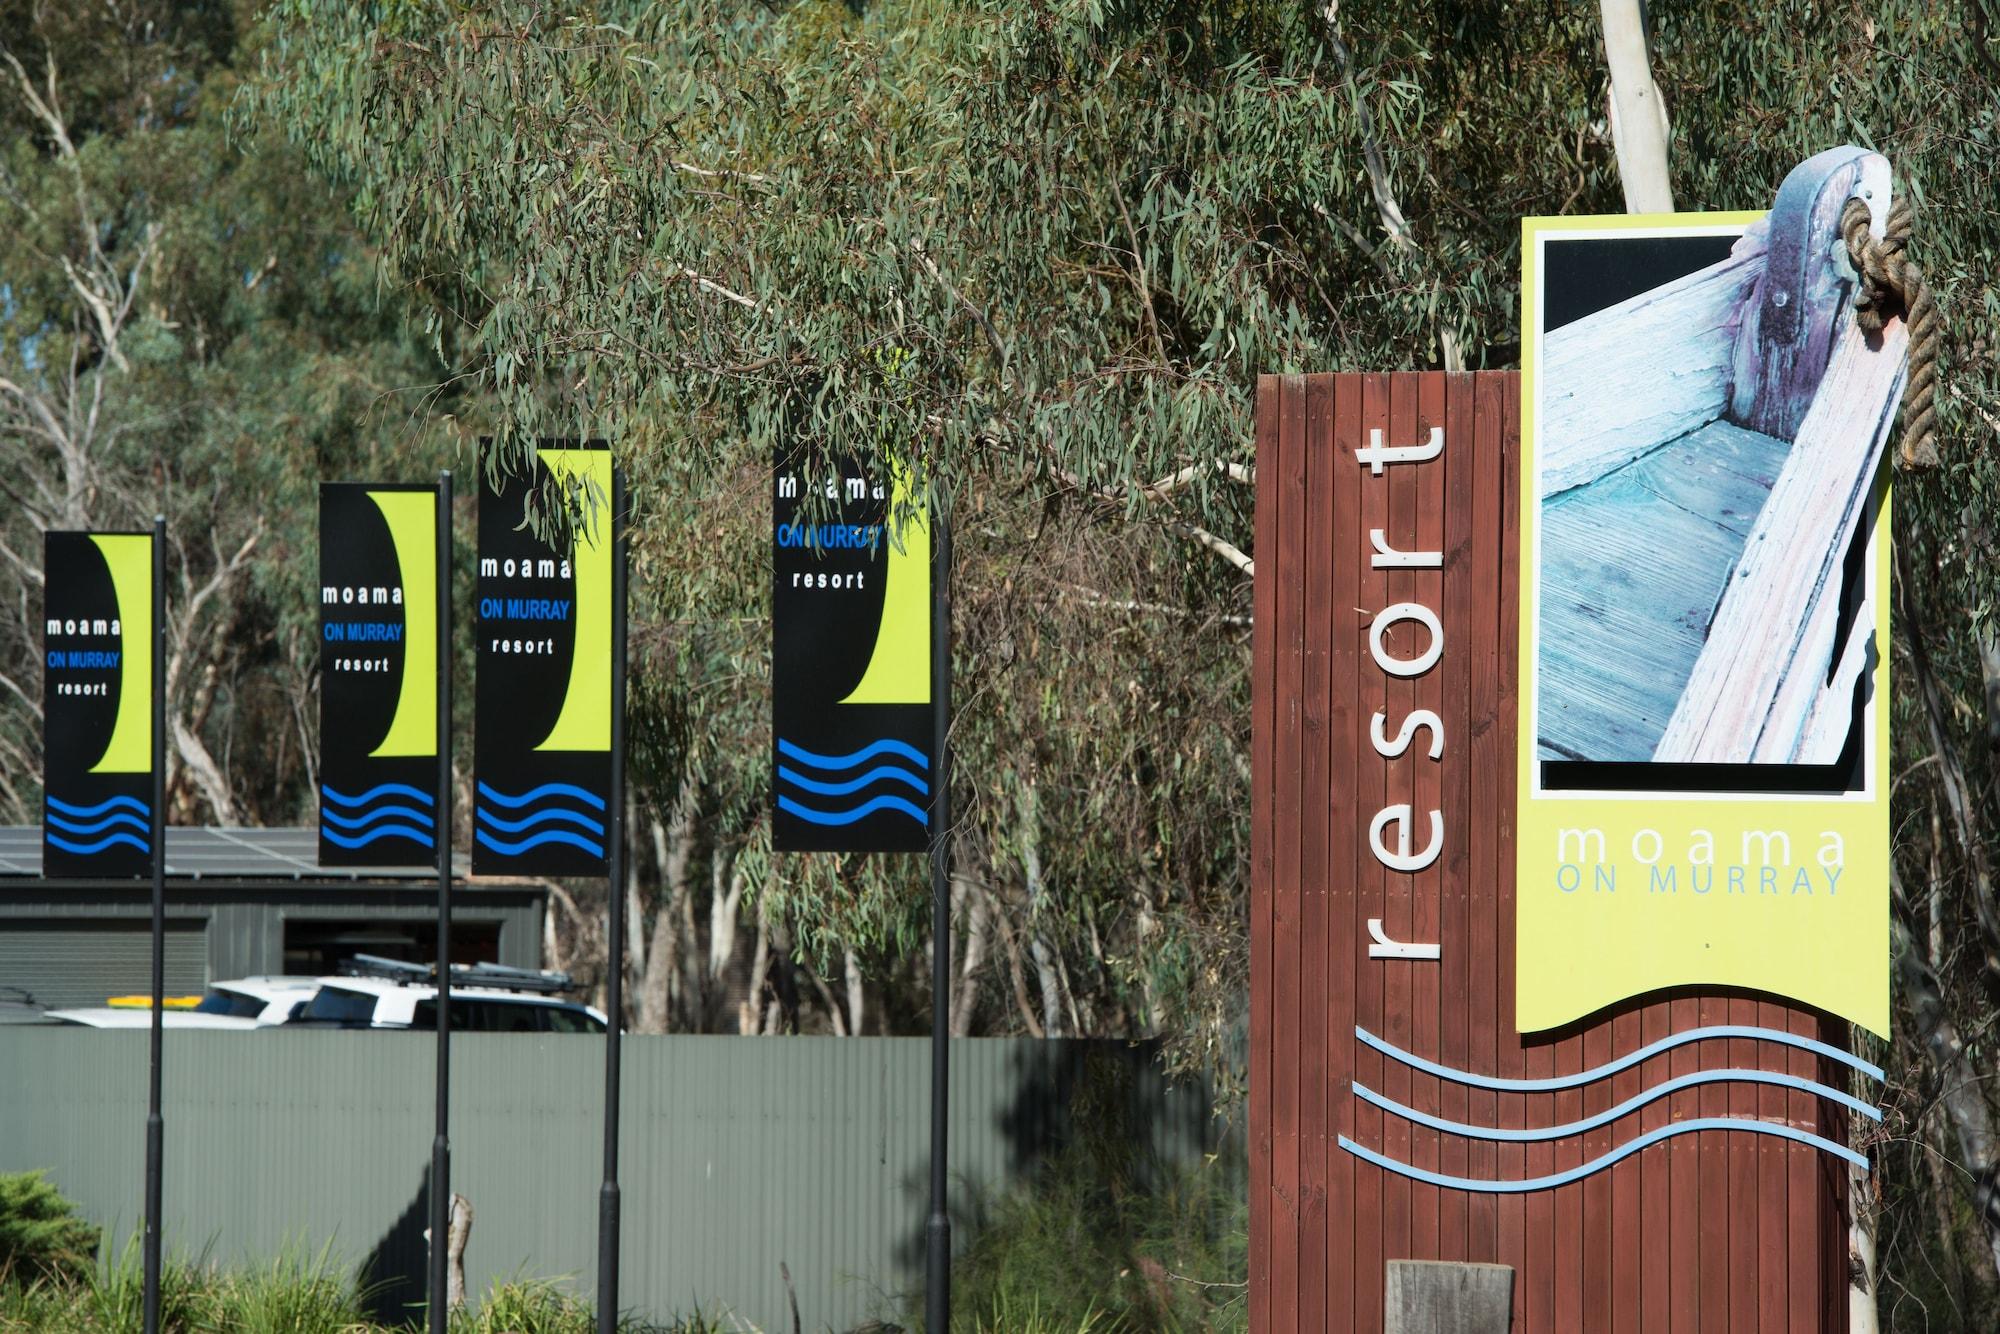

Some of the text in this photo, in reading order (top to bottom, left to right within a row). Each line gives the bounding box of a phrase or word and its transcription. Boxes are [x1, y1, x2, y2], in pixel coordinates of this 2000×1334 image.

[778, 523, 803, 547] ON
[481, 558, 572, 579] moama
[793, 571, 864, 589] resort
[322, 586, 402, 604] moama
[481, 598, 570, 621] ON MURRAY
[47, 619, 121, 636] moama
[324, 623, 402, 642] ON MURRAY
[492, 638, 553, 655] resort
[47, 651, 120, 668] ON MURRAY
[334, 657, 389, 672] resort
[57, 682, 107, 696] resort
[1354, 427, 1444, 961] resort
[1557, 828, 1845, 867] moama
[1557, 864, 1843, 896] ON MURRAY
